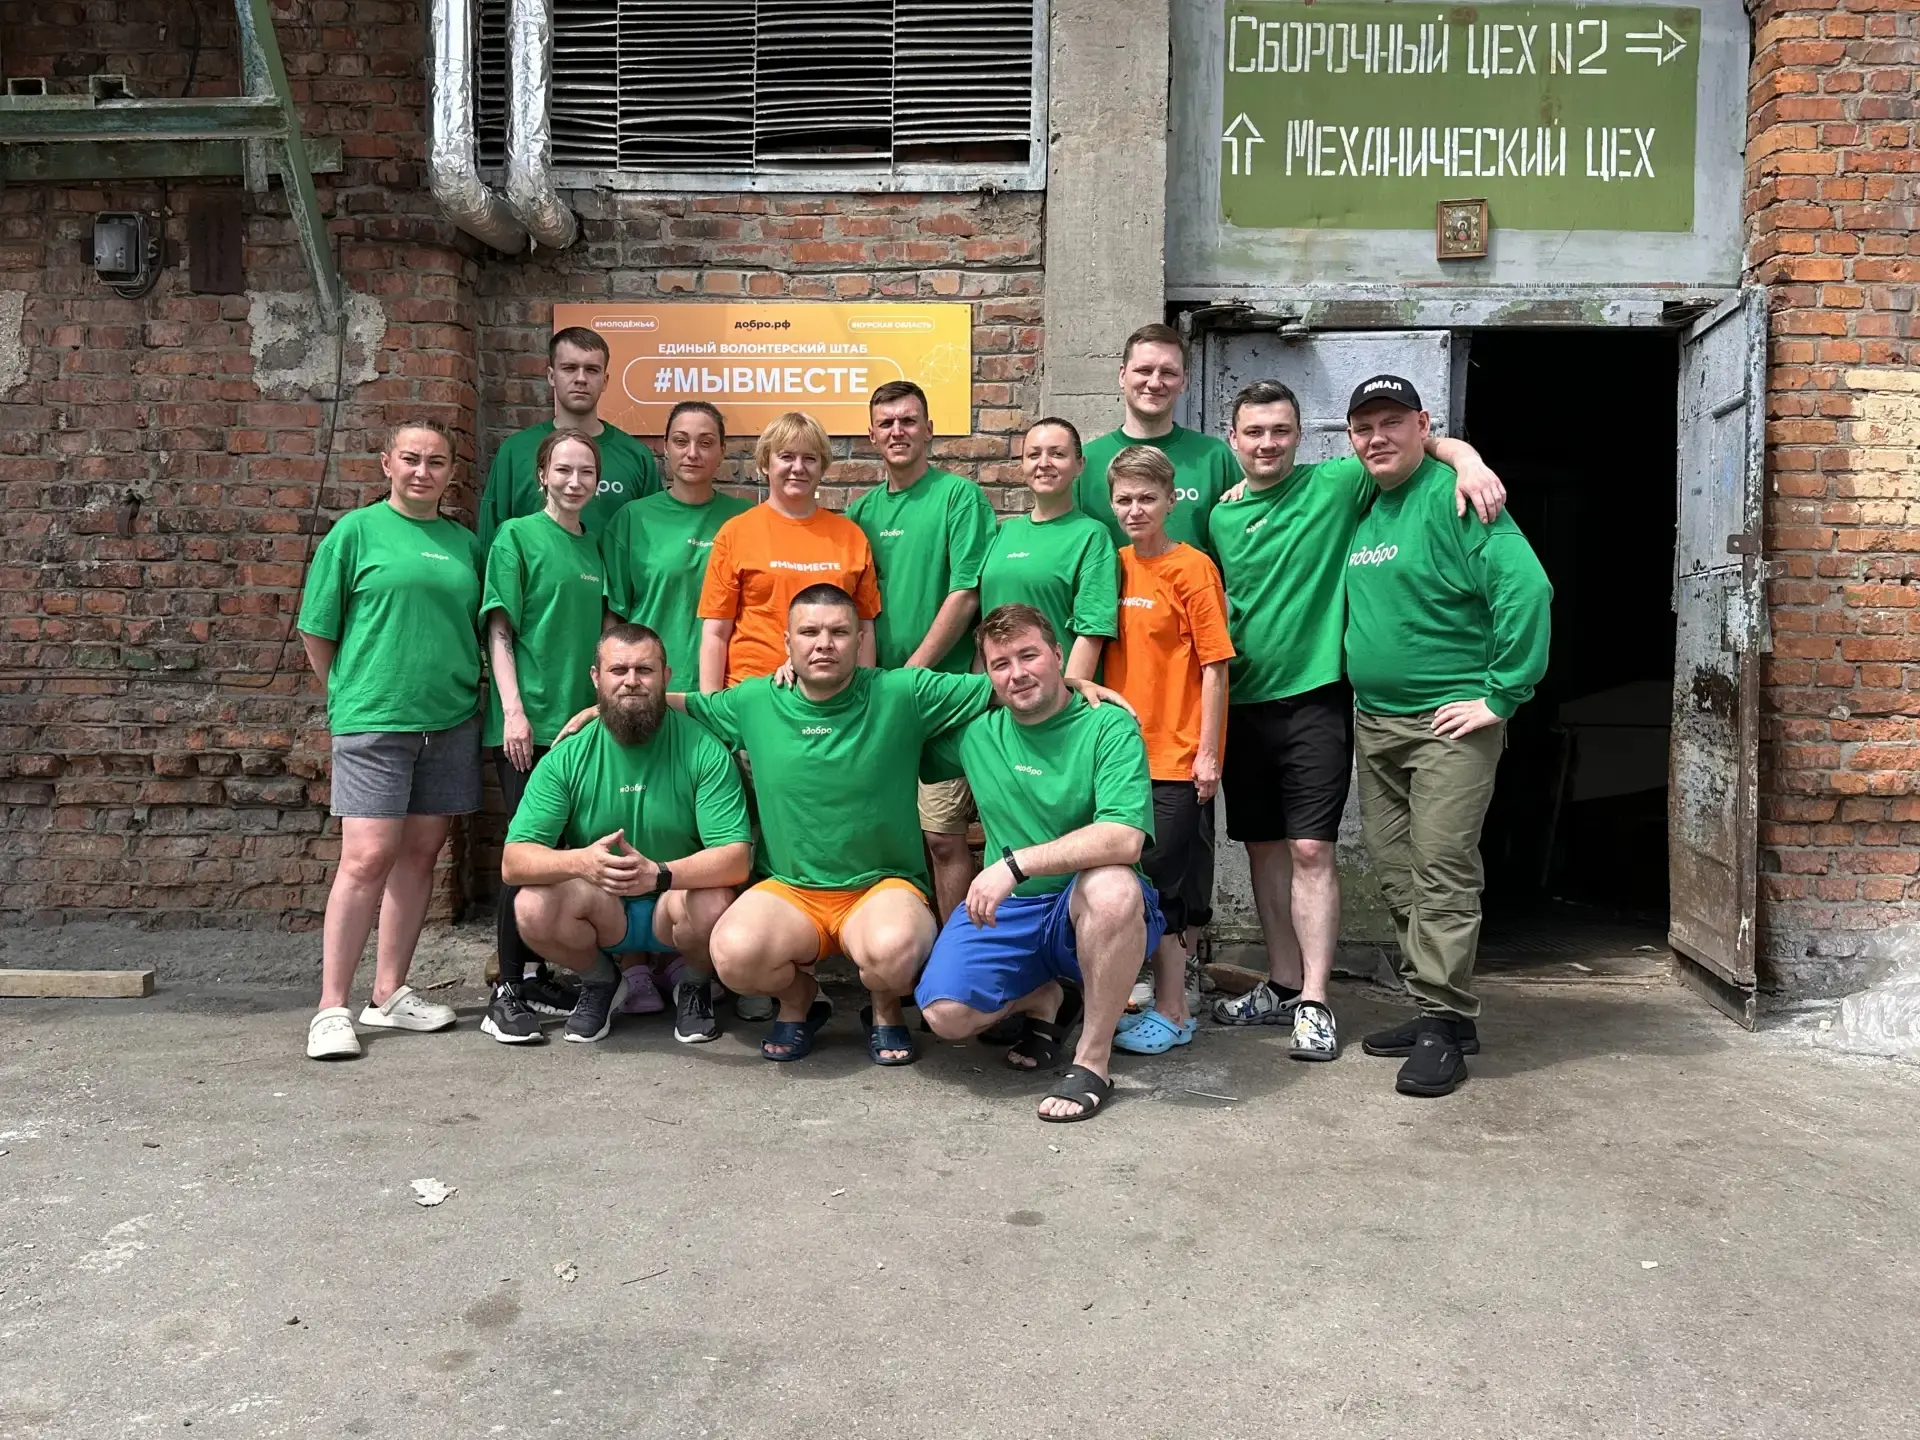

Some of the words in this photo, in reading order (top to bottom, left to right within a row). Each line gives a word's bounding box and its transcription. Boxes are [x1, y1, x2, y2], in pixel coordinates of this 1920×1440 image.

[1467, 24, 1539, 79] ЦЕХ
[1586, 127, 1656, 182] ЦЕХ
[595, 320, 655, 329] #МОЛОДЁЖЬ46
[734, 319, 791, 331] добро.рф
[658, 342, 717, 355] ЕДИНЫЙ
[719, 342, 827, 354] ВОЛОНТЕРСКИЙ
[829, 343, 868, 354] ШТАБ
[653, 367, 869, 394] #МЫВМЕСТЕ
[1363, 380, 1402, 394] ЯМАЛ
[769, 560, 841, 572] #МЫВМЕСТЕ
